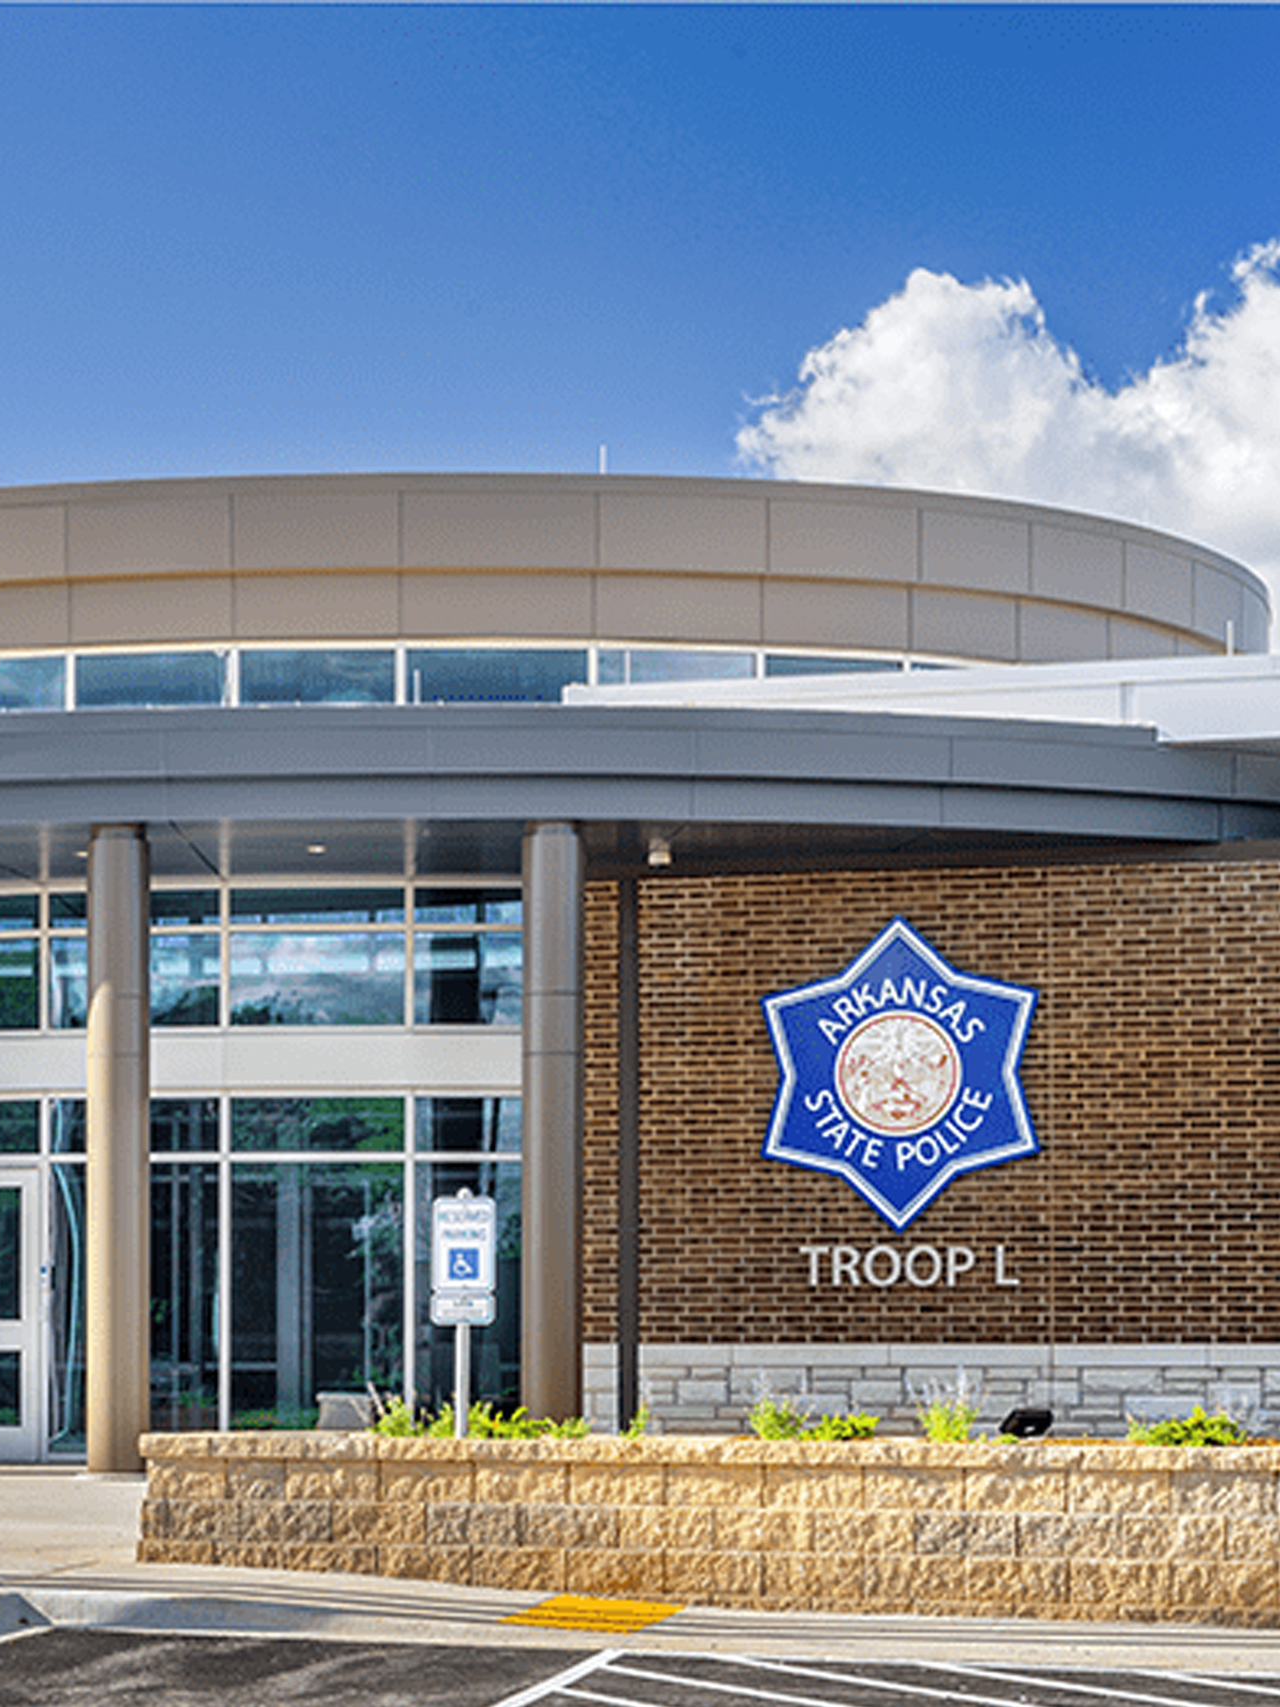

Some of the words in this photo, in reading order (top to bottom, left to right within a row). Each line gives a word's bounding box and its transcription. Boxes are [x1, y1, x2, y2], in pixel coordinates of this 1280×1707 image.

[818, 977, 985, 1045] ARKANSAS
[805, 1089, 883, 1169] STATE
[895, 1087, 993, 1171] POLICE
[799, 1244, 976, 1287] TROOP
[995, 1244, 1020, 1286] L
